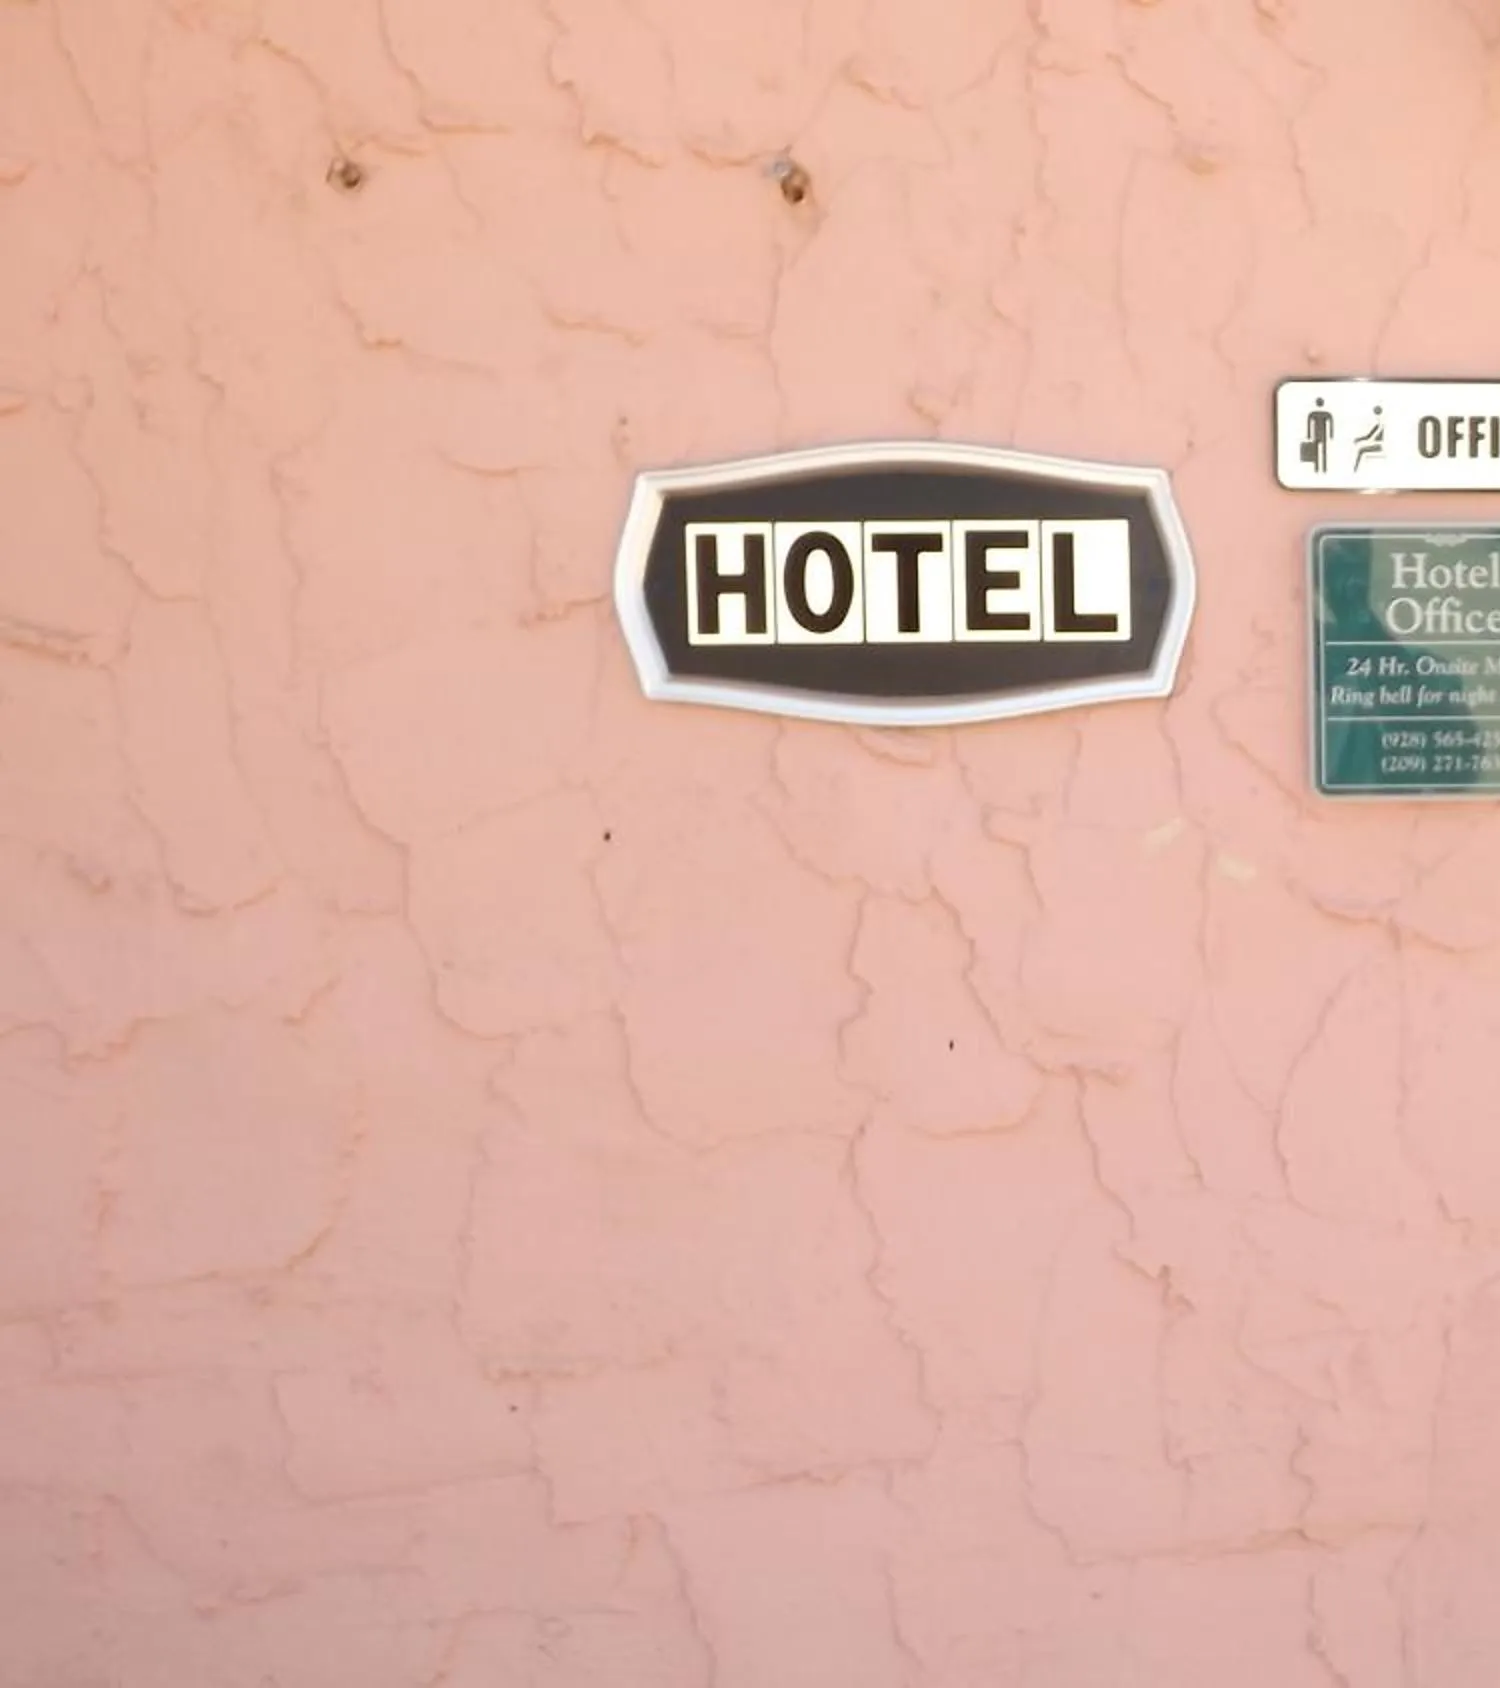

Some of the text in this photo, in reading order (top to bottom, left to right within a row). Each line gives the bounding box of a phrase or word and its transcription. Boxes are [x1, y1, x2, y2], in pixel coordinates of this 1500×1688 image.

[695, 530, 1119, 634] HOTEL
[1391, 552, 1500, 590] Hotel
[1346, 657, 1371, 677] 24
[1378, 656, 1410, 675] Hr.
[1415, 655, 1478, 676] Onsite
[1331, 685, 1375, 708] Ring
[1380, 685, 1411, 704] bell
[1416, 685, 1444, 708] for
[1449, 684, 1496, 708] night
[1381, 732, 1427, 749] (928)
[1381, 755, 1427, 773] (209)
